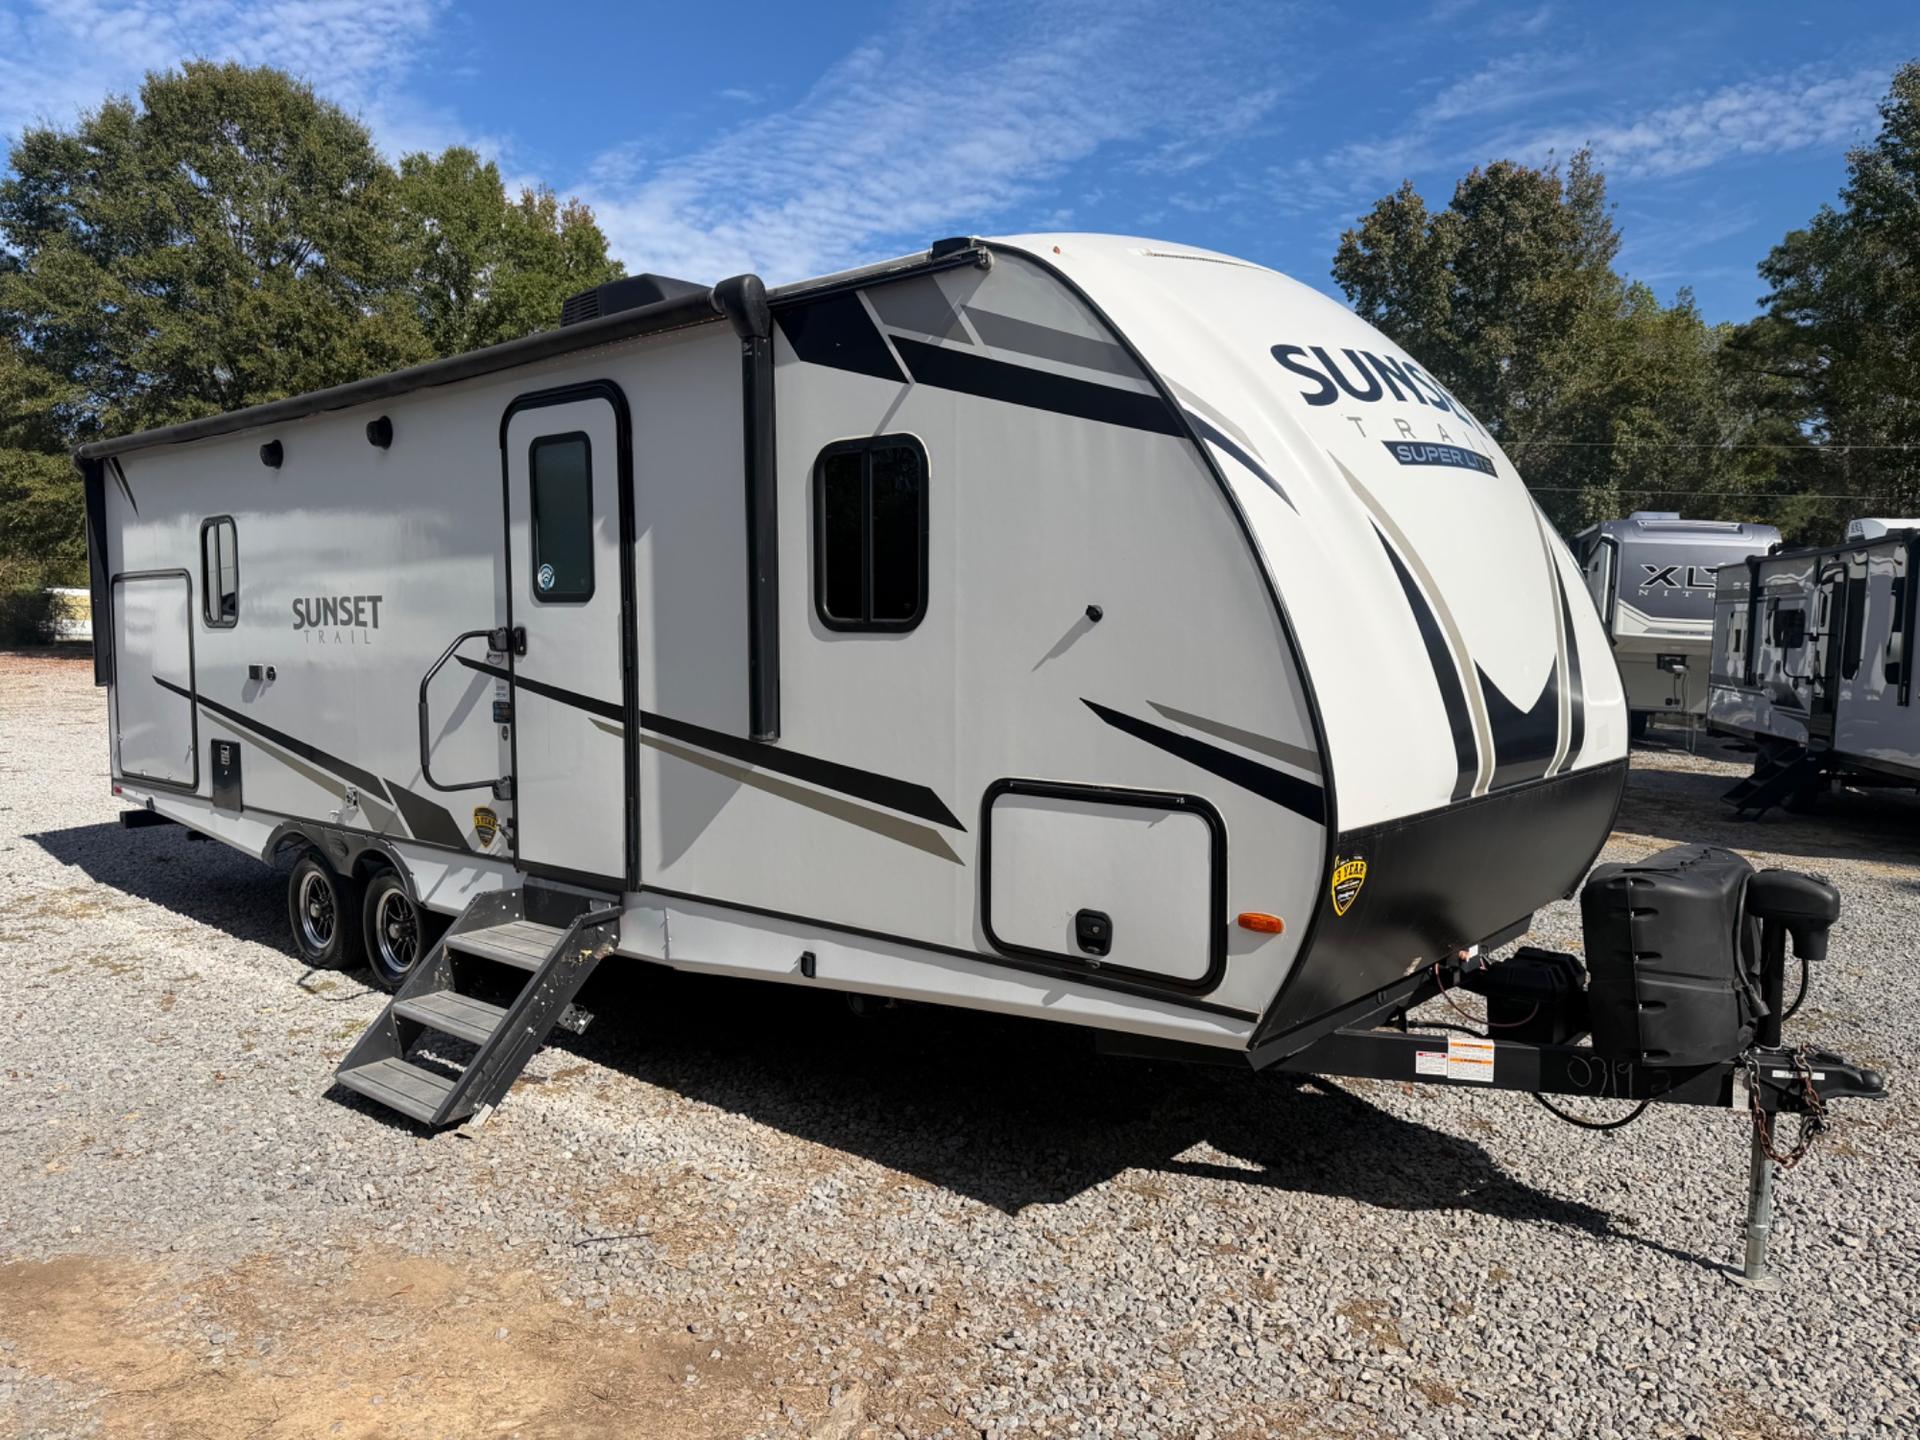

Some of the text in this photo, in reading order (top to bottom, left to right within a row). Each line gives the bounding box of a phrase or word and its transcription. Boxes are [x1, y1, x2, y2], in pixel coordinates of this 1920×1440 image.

[1347, 416, 1494, 460] TRAIL
[1396, 444, 1495, 475] SUPER LITE
[292, 595, 383, 630] SUNSET
[304, 629, 371, 644] TRAIL
[1344, 862, 1365, 878] YEAR
